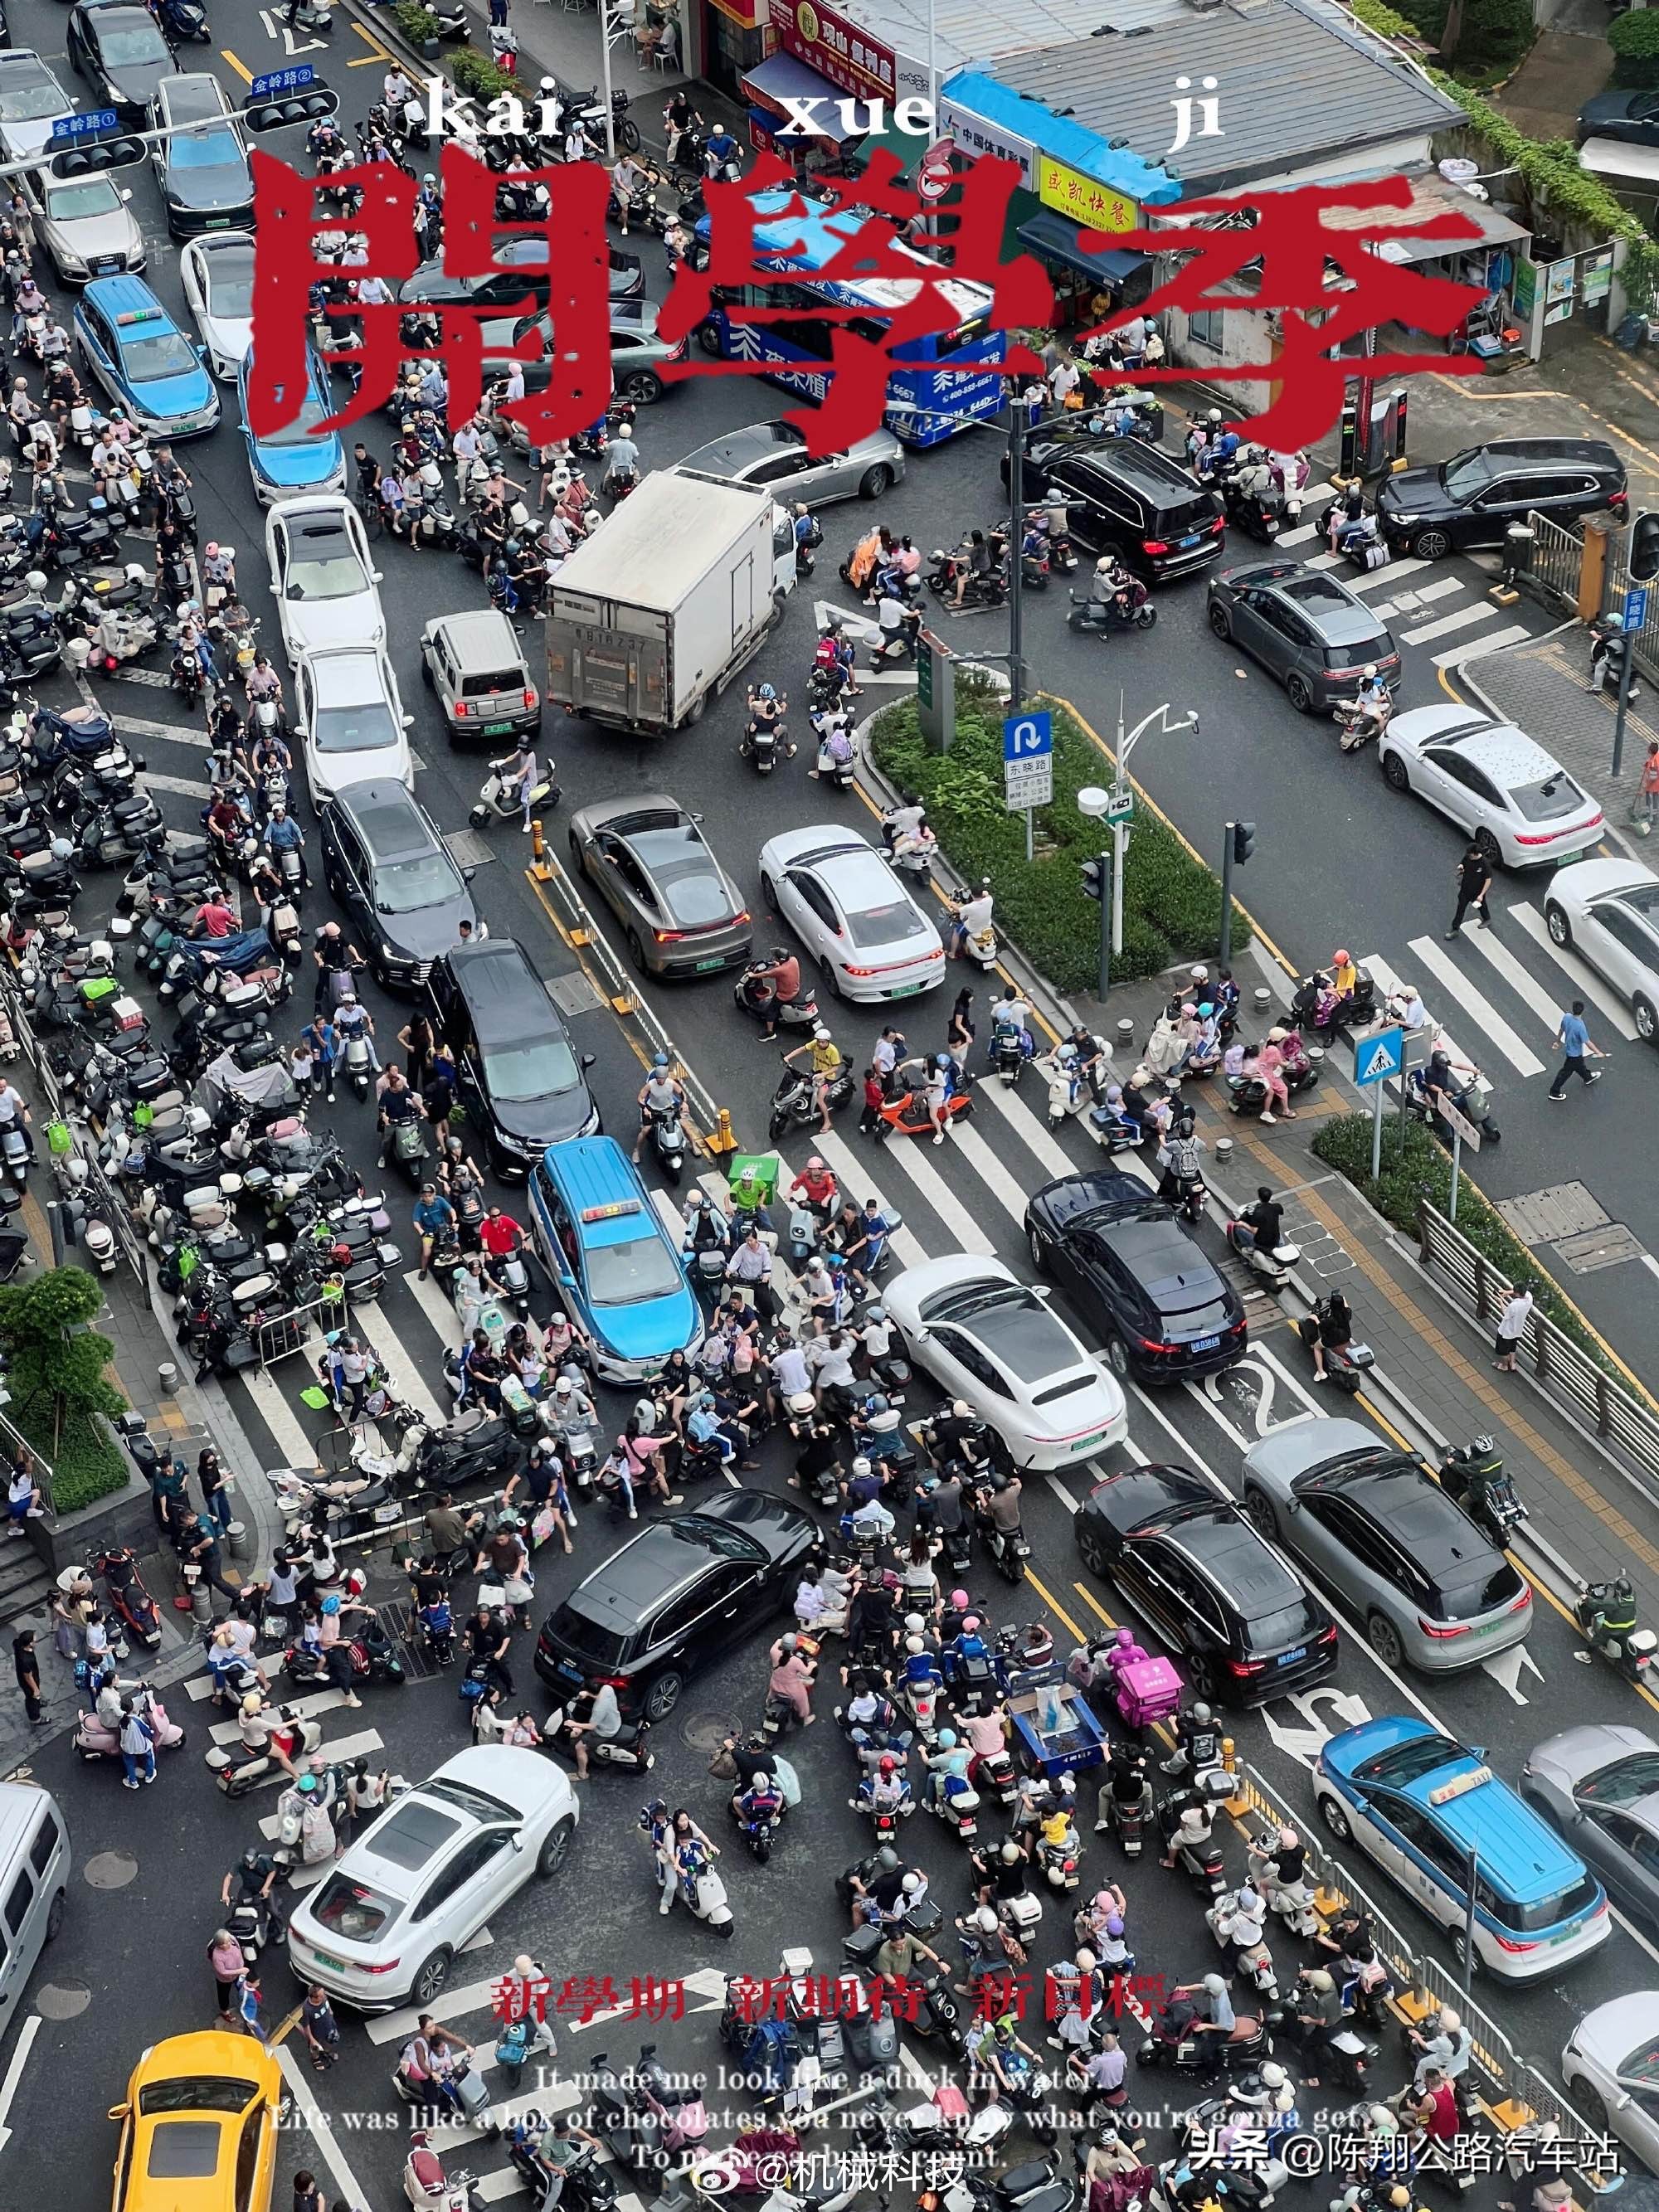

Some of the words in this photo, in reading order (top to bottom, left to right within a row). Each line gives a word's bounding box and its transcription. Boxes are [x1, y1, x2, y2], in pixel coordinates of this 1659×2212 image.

[1048, 169, 1130, 226] 盛凯快餐
[1010, 759, 1047, 776] 东晓路
